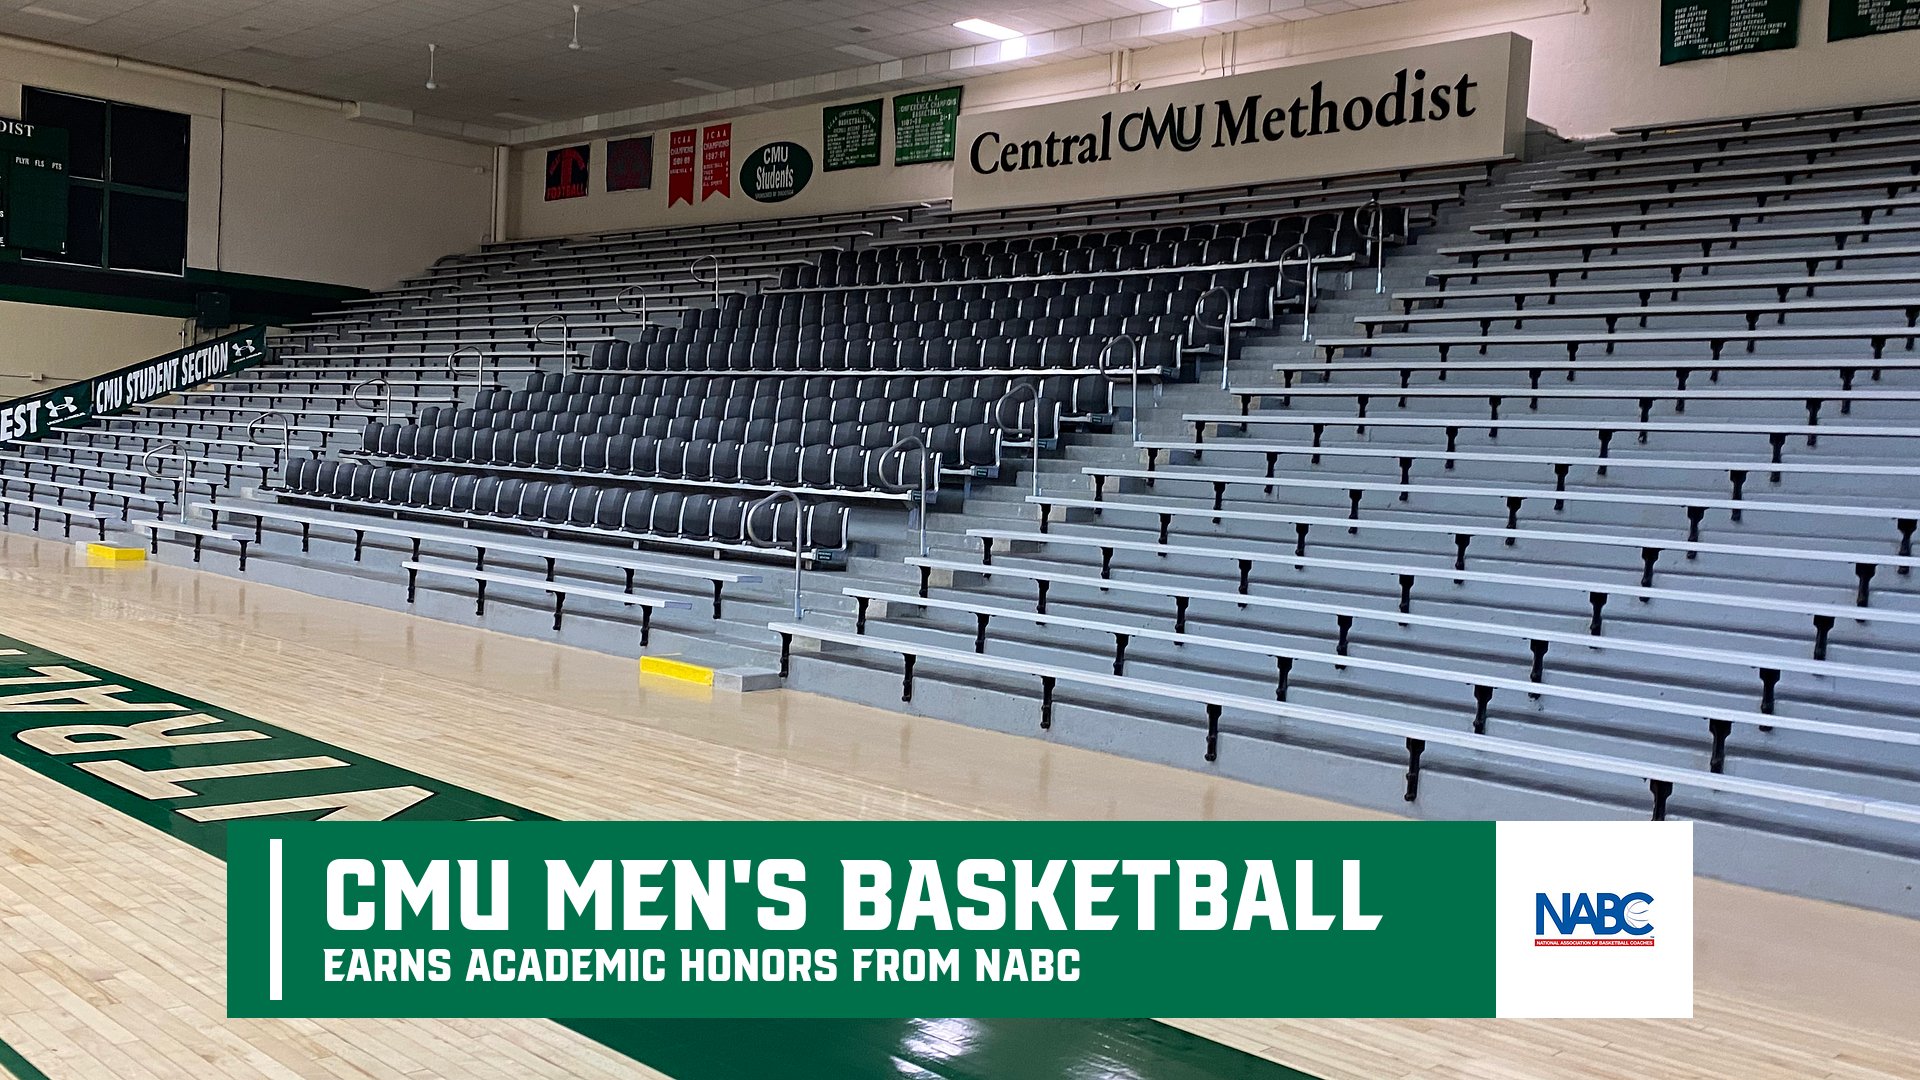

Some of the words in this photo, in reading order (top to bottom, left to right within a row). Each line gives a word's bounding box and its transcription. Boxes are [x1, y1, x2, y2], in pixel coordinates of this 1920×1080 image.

[970, 111, 1112, 175] Central
[1118, 102, 1204, 152] CMU
[1211, 68, 1478, 148] Methodist
[15, 156, 30, 165] PLYR
[34, 159, 45, 167] FLS
[51, 162, 62, 170] PTS
[763, 145, 789, 165] CMU
[756, 164, 794, 191] Students
[546, 183, 586, 200] FOOTBALL
[96, 381, 123, 414] CMU
[126, 356, 180, 406] STUDENT
[181, 341, 230, 385] SECTION
[0, 400, 41, 442] EST
